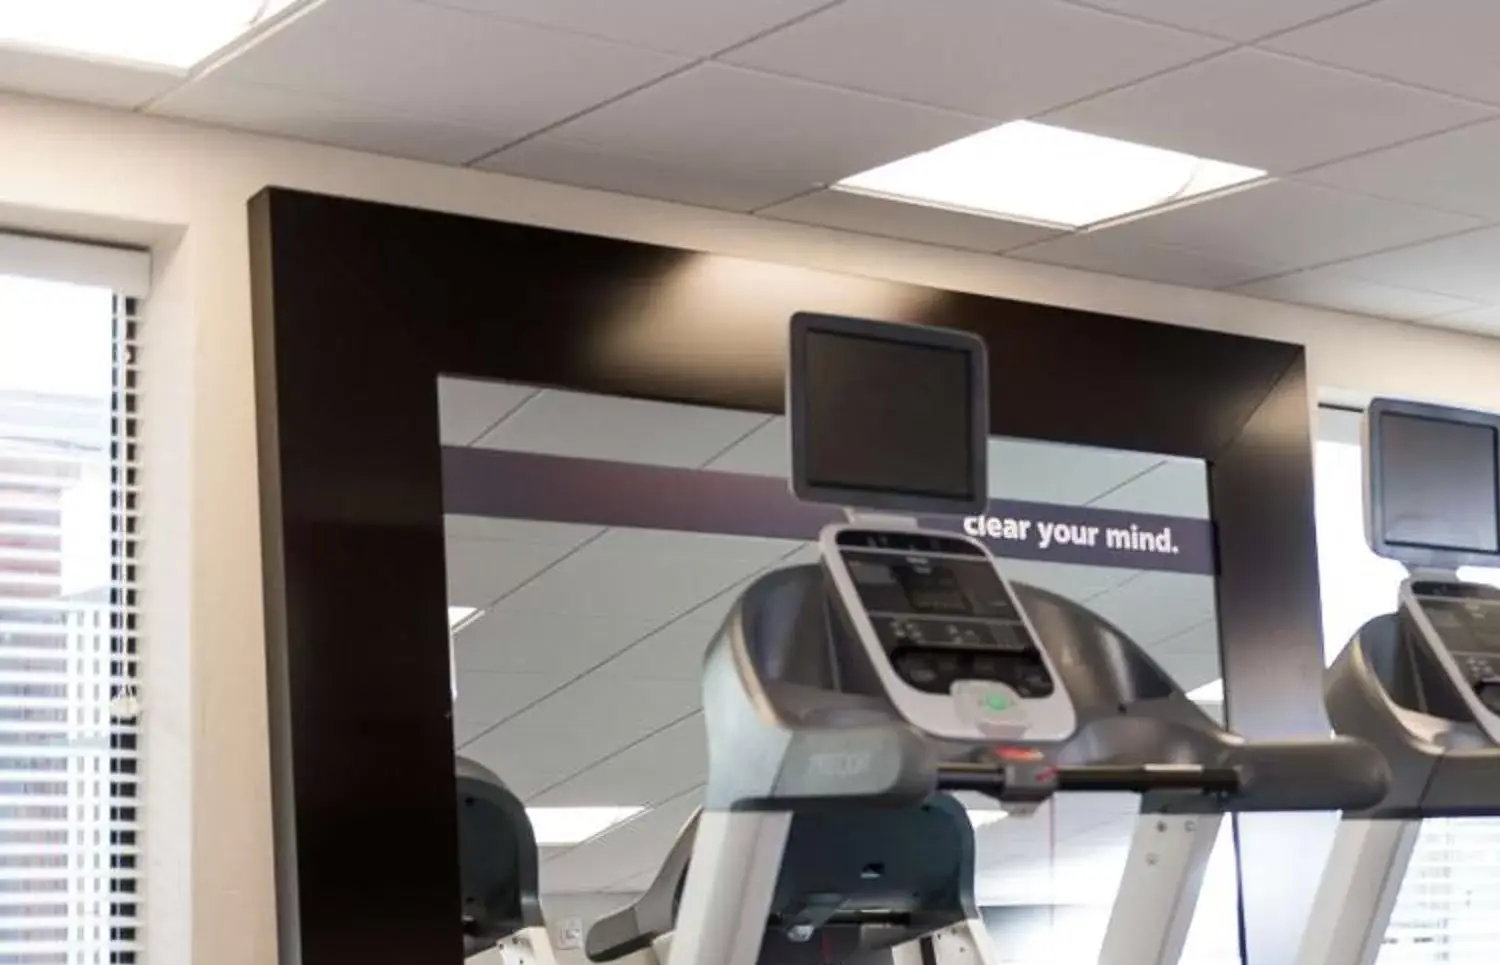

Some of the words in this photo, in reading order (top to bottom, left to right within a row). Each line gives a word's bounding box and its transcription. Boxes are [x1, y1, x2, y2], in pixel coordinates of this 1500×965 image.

[963, 515, 1031, 540] clear
[1036, 521, 1099, 549] your
[1105, 524, 1180, 554] mind.
